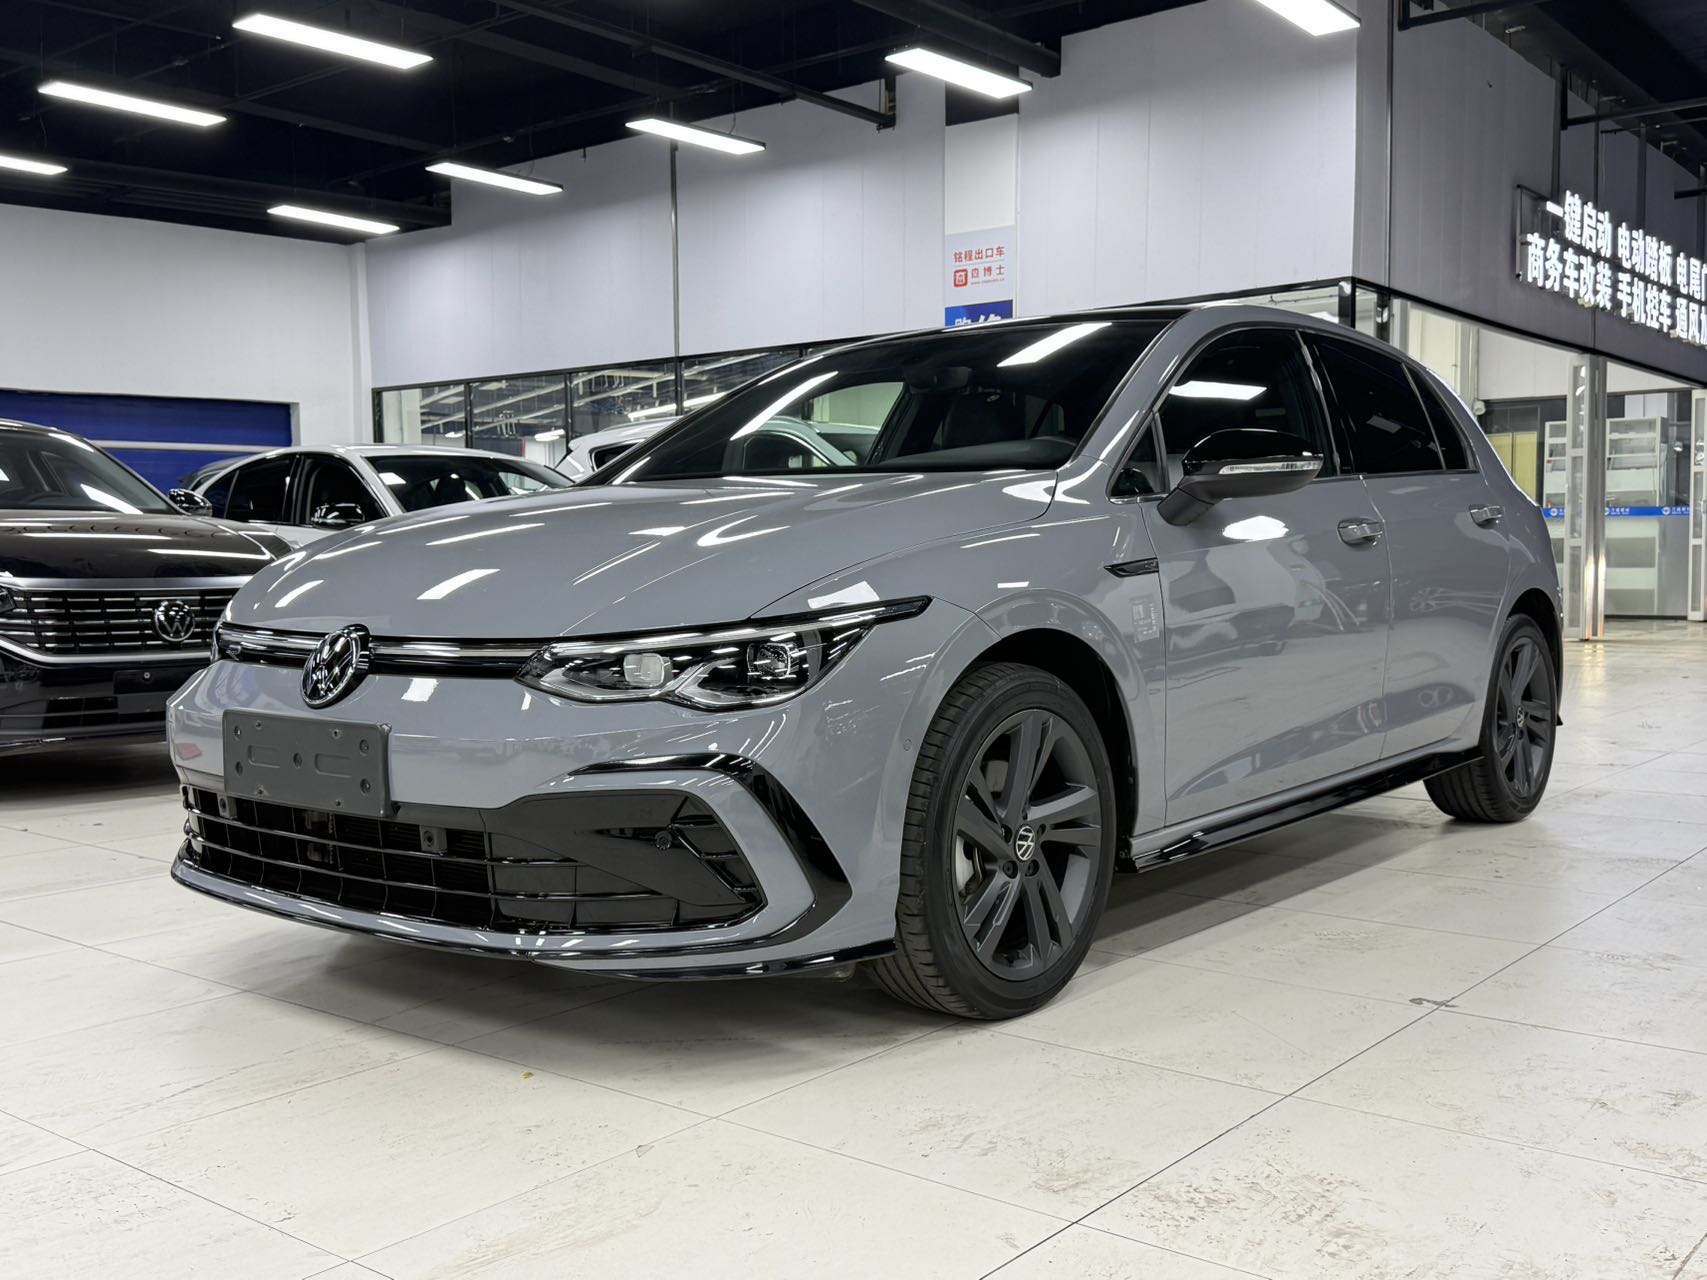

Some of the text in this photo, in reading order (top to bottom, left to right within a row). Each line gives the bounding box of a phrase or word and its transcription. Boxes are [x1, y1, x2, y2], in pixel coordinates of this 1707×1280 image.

[1527, 232, 1613, 310] 商务车改装
[1617, 272, 1672, 333] 手机控车
[1546, 189, 1612, 258] 一键启动
[1618, 221, 1672, 286] 电动踏板
